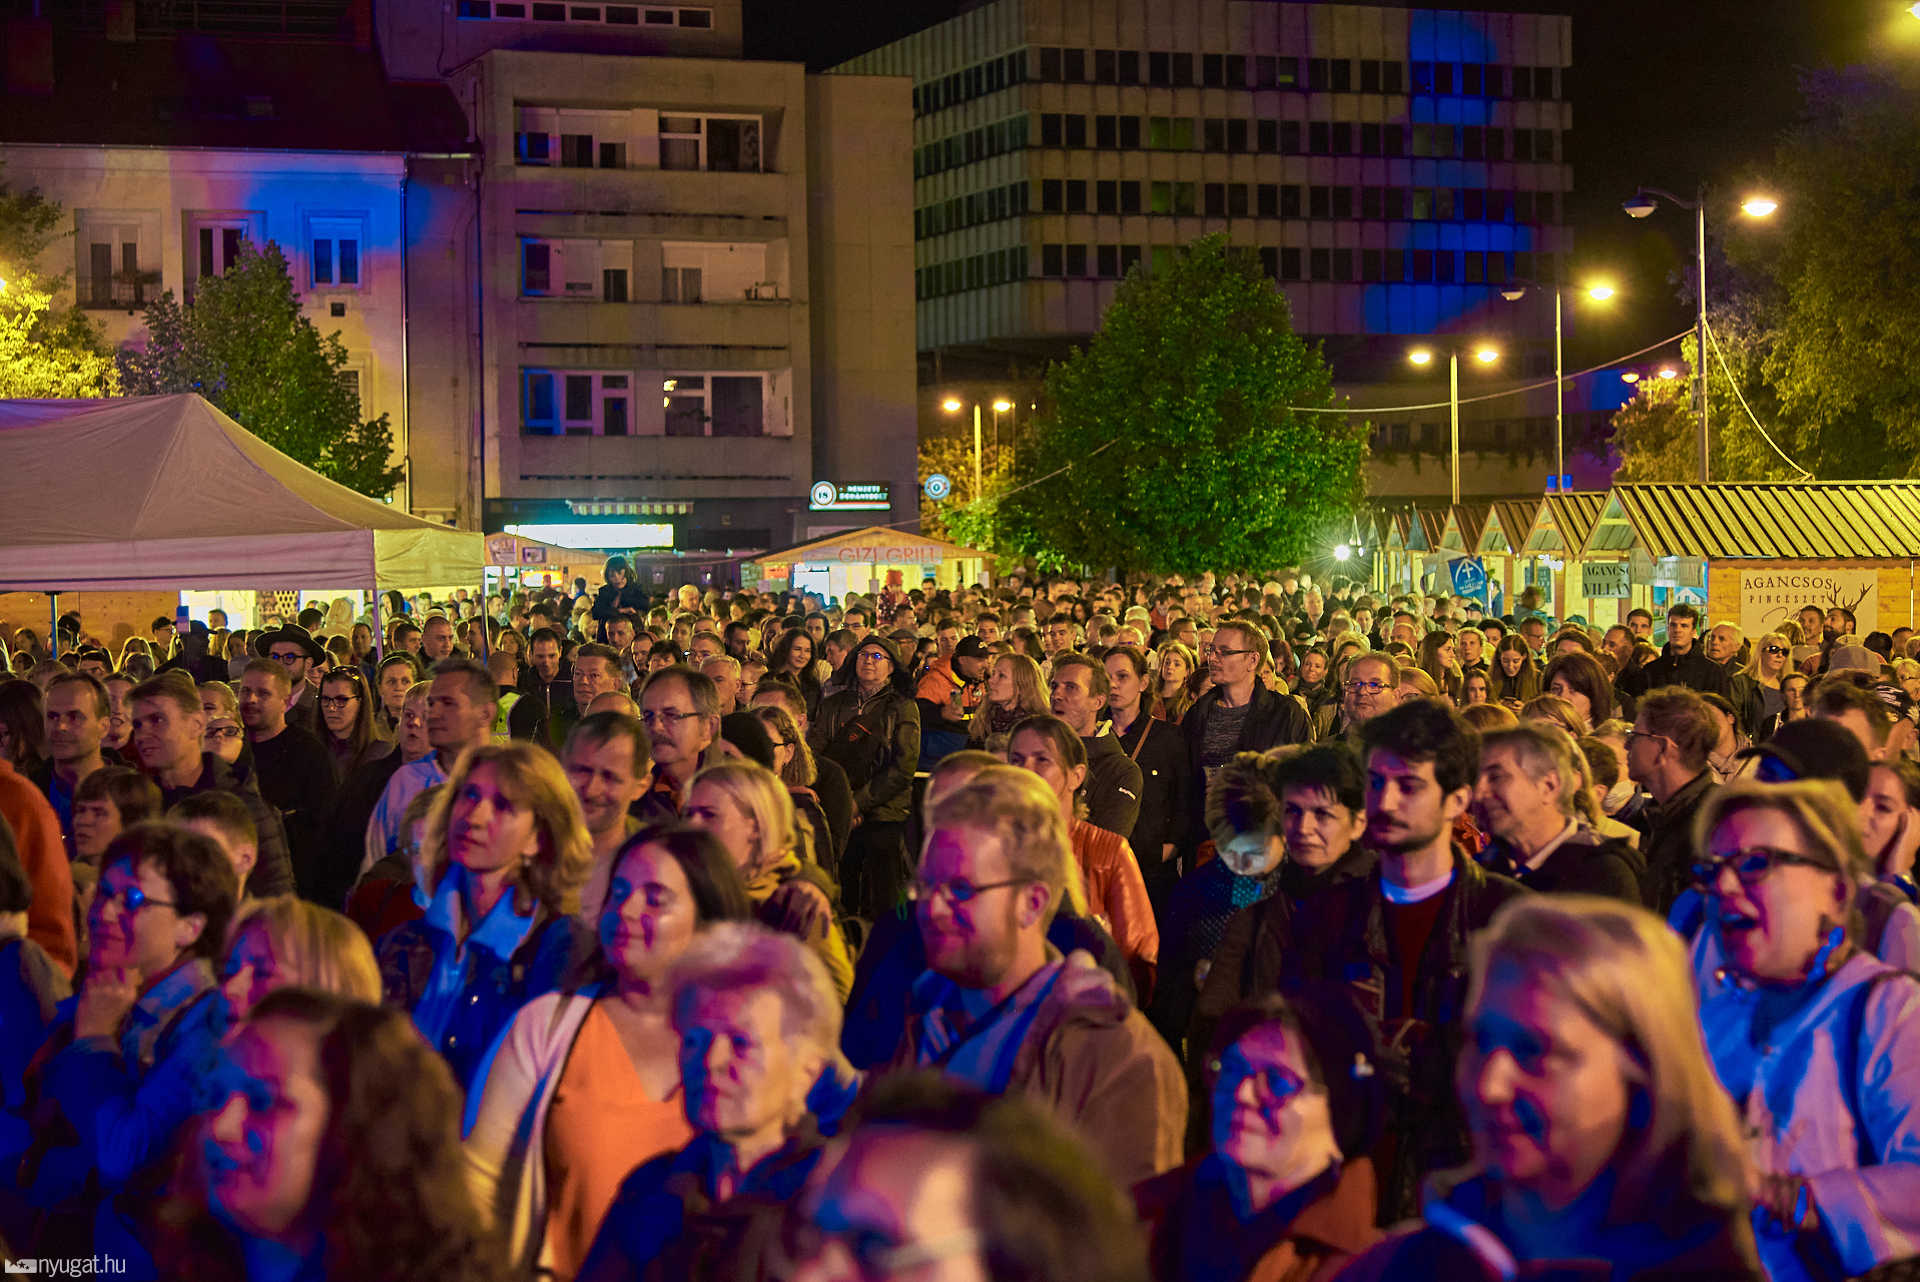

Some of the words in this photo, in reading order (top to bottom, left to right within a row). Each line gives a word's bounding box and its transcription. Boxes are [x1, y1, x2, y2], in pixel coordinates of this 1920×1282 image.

[838, 547, 878, 563] GIZI
[886, 547, 938, 564] GRILL
[1744, 575, 1833, 590] AGANCSOS
